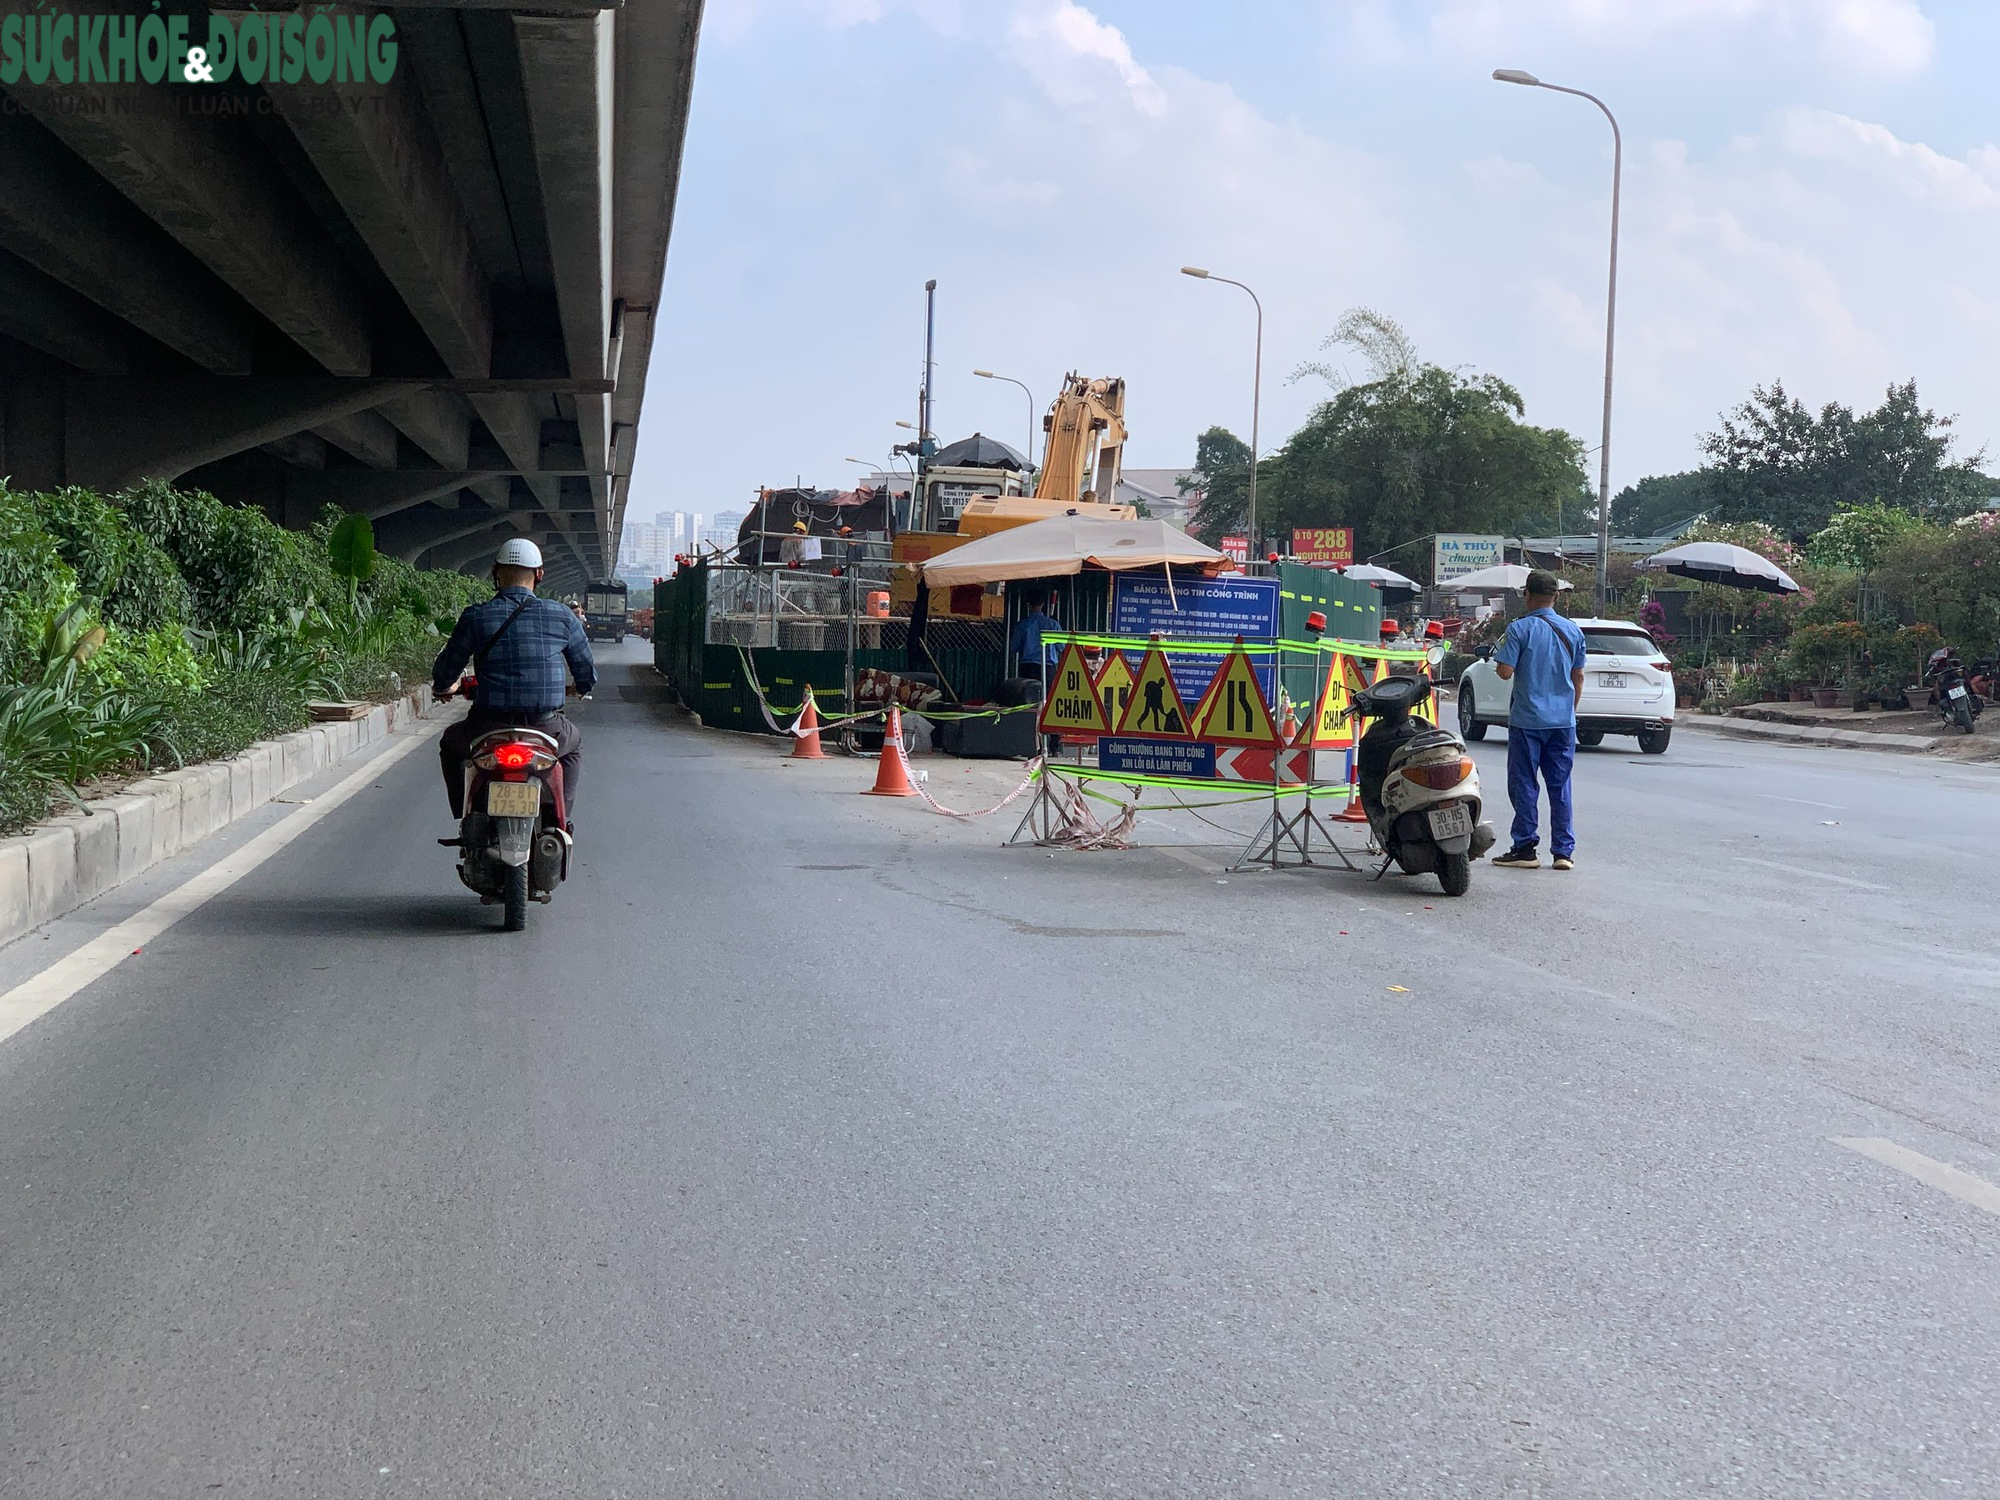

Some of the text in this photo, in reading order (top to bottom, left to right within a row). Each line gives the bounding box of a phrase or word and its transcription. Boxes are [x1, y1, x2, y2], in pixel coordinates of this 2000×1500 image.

[1313, 530, 1347, 549] 288
[1441, 540, 1459, 550] HÀ
[1133, 584, 1157, 594] BẢNG
[1191, 589, 1205, 597] TIN
[1206, 588, 1232, 599] CÔNG
[1234, 590, 1259, 600] TRÌNH
[1067, 670, 1079, 691] ĐI
[1332, 681, 1340, 700] ĐI
[1055, 695, 1092, 724] CHẬM
[1109, 742, 1205, 759] CÔNG TRƯỜNG ĐANG THI CÔNG
[1122, 758, 1133, 769] XIN
[1156, 758, 1171, 771] LÀM
[493, 800, 535, 815] 175.30
[1434, 808, 1463, 824] 30-H5
[1438, 821, 1465, 837] 0567
